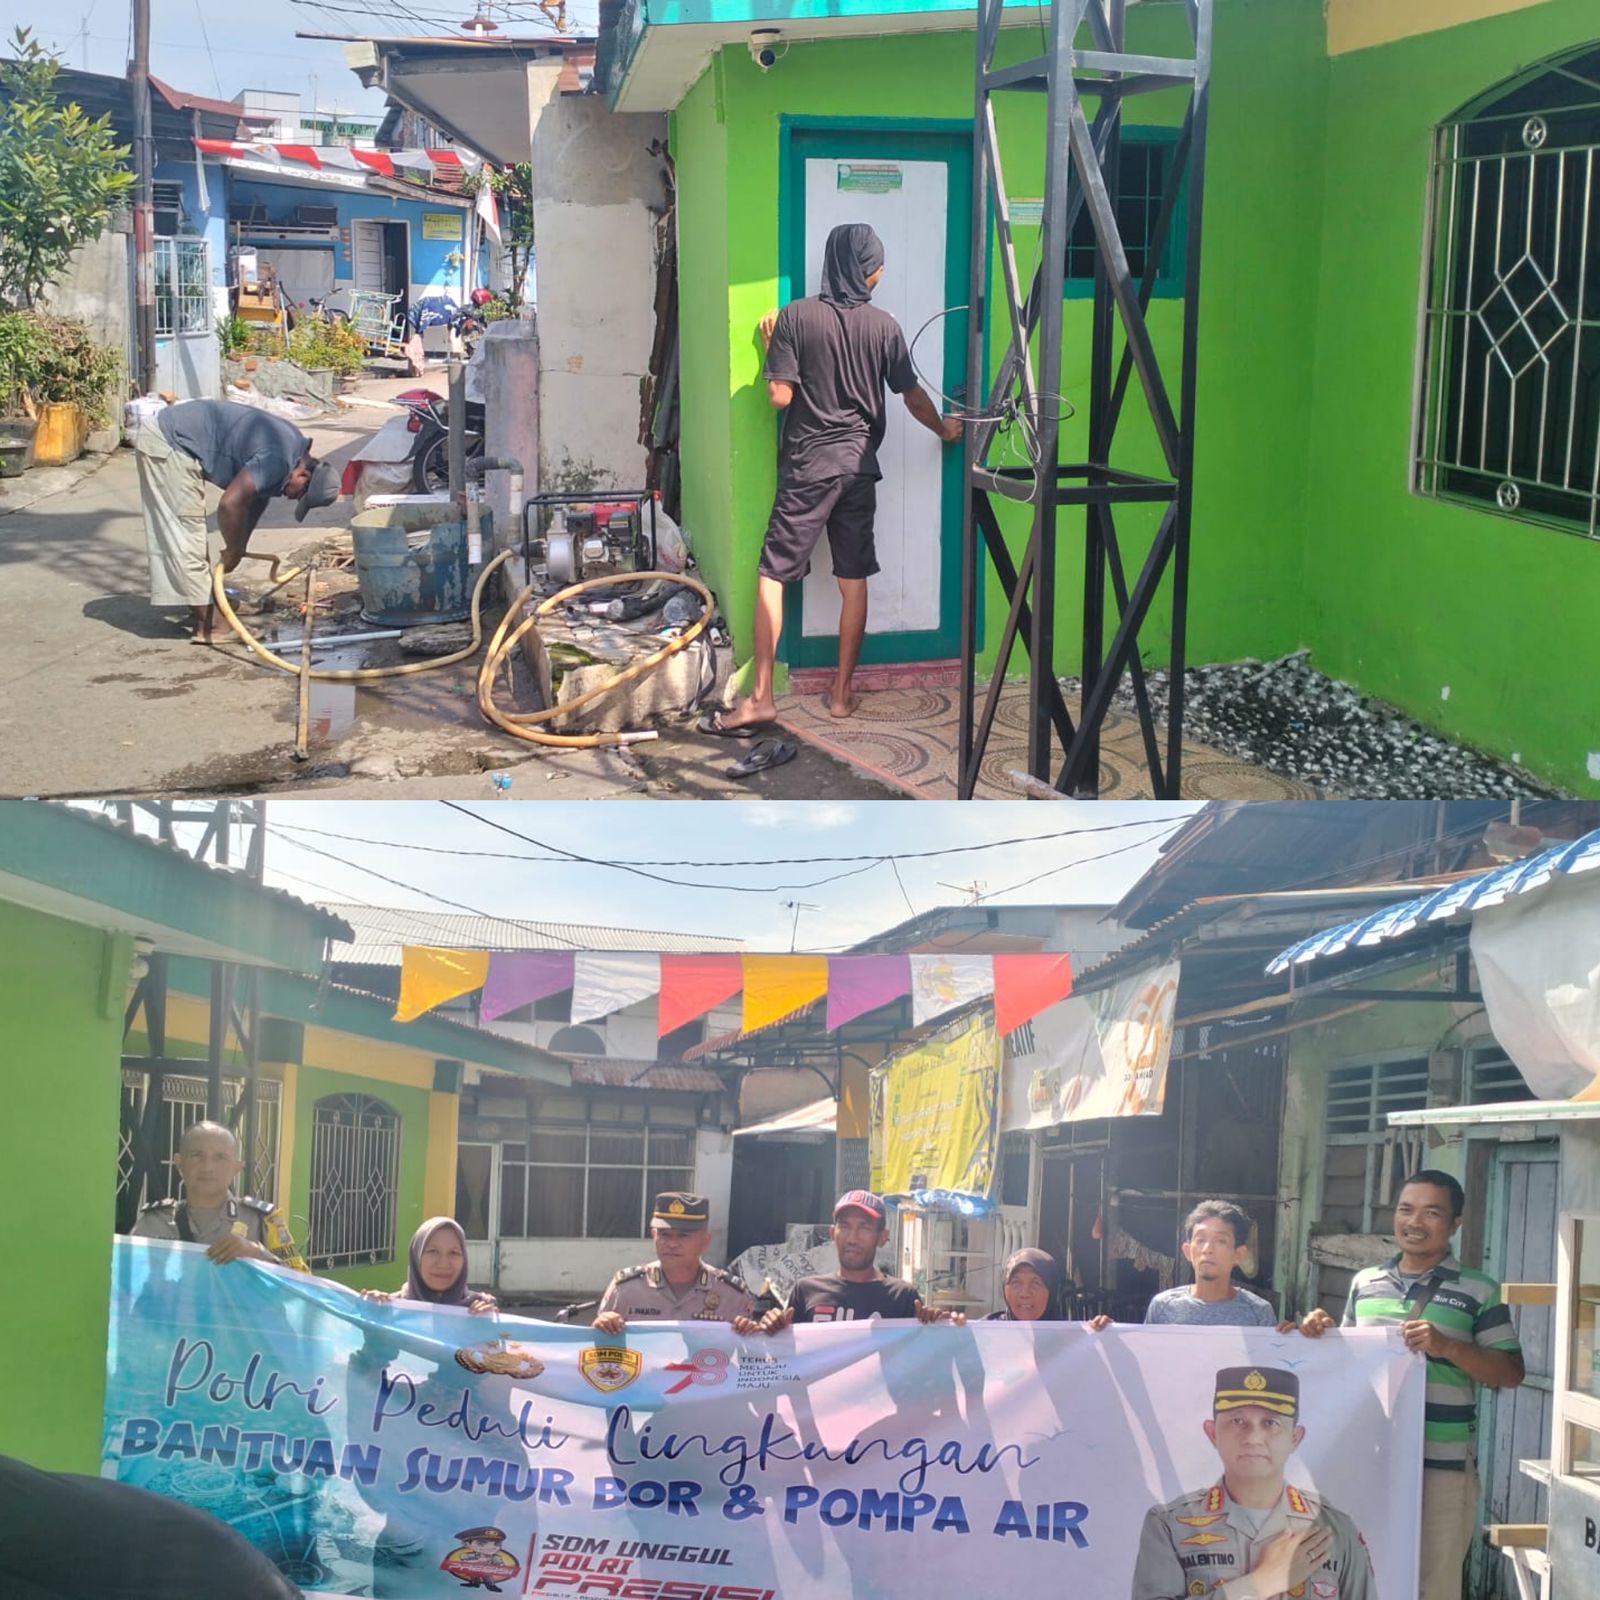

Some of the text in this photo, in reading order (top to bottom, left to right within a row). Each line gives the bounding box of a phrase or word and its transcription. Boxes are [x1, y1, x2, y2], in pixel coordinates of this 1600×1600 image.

[739, 1363, 788, 1371] MELAJU
[740, 1356, 778, 1364] TERUS
[166, 1338, 337, 1415] Polri
[373, 1370, 569, 1449] Peduli
[737, 1375, 801, 1383] INDONESIA
[121, 1418, 1089, 1549] BANTUAN SUMUR BOR & POMPA AIR
[542, 1533, 734, 1566] SDM UNGGUL
[1584, 1516, 1600, 1555] B
[538, 1552, 634, 1575] POLRI
[533, 1570, 776, 1600] PRESISI
